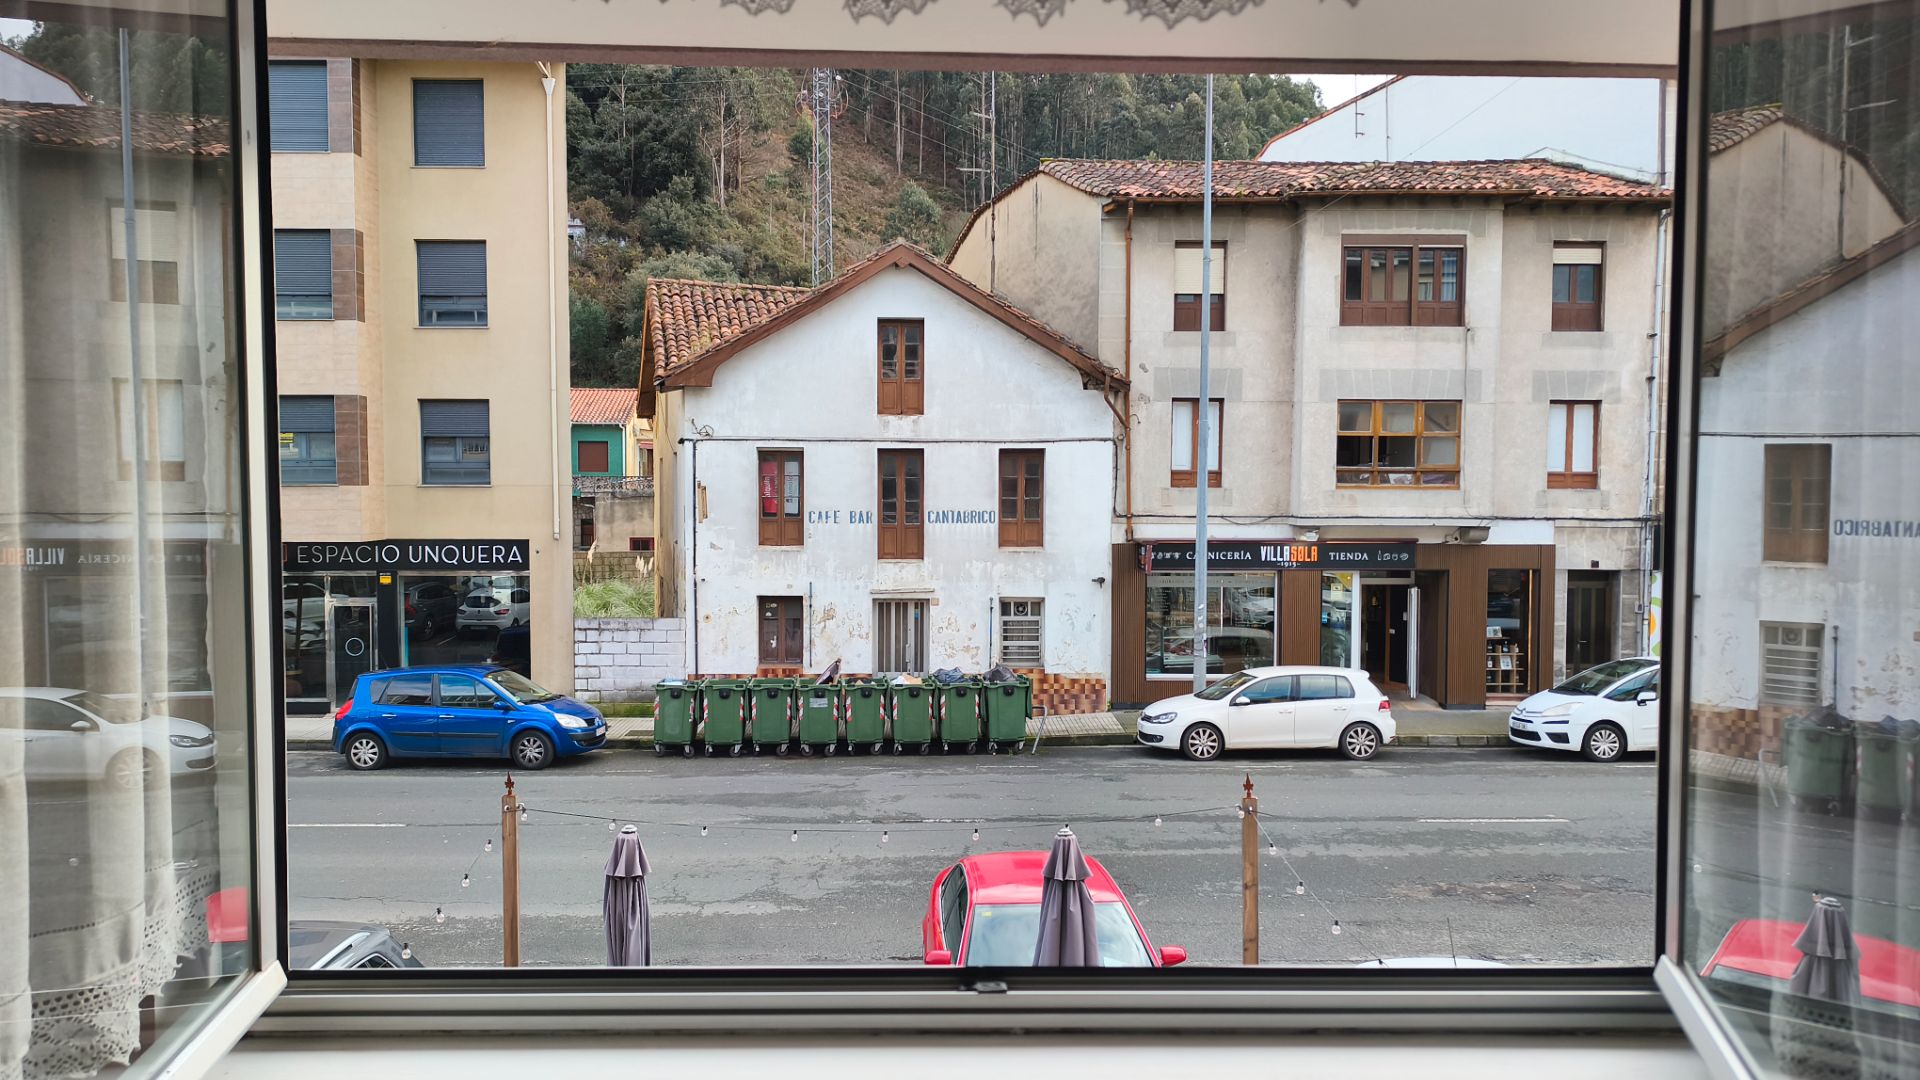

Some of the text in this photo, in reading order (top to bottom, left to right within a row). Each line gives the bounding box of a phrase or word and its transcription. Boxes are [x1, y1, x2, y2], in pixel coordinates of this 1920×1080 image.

[807, 509, 996, 525] CAFE BAR CANTABRICO
[297, 545, 523, 565] ESPACIO UNQUERA
[1185, 550, 1252, 560] CNICERÍA
[1328, 551, 1369, 561] TIENDA
